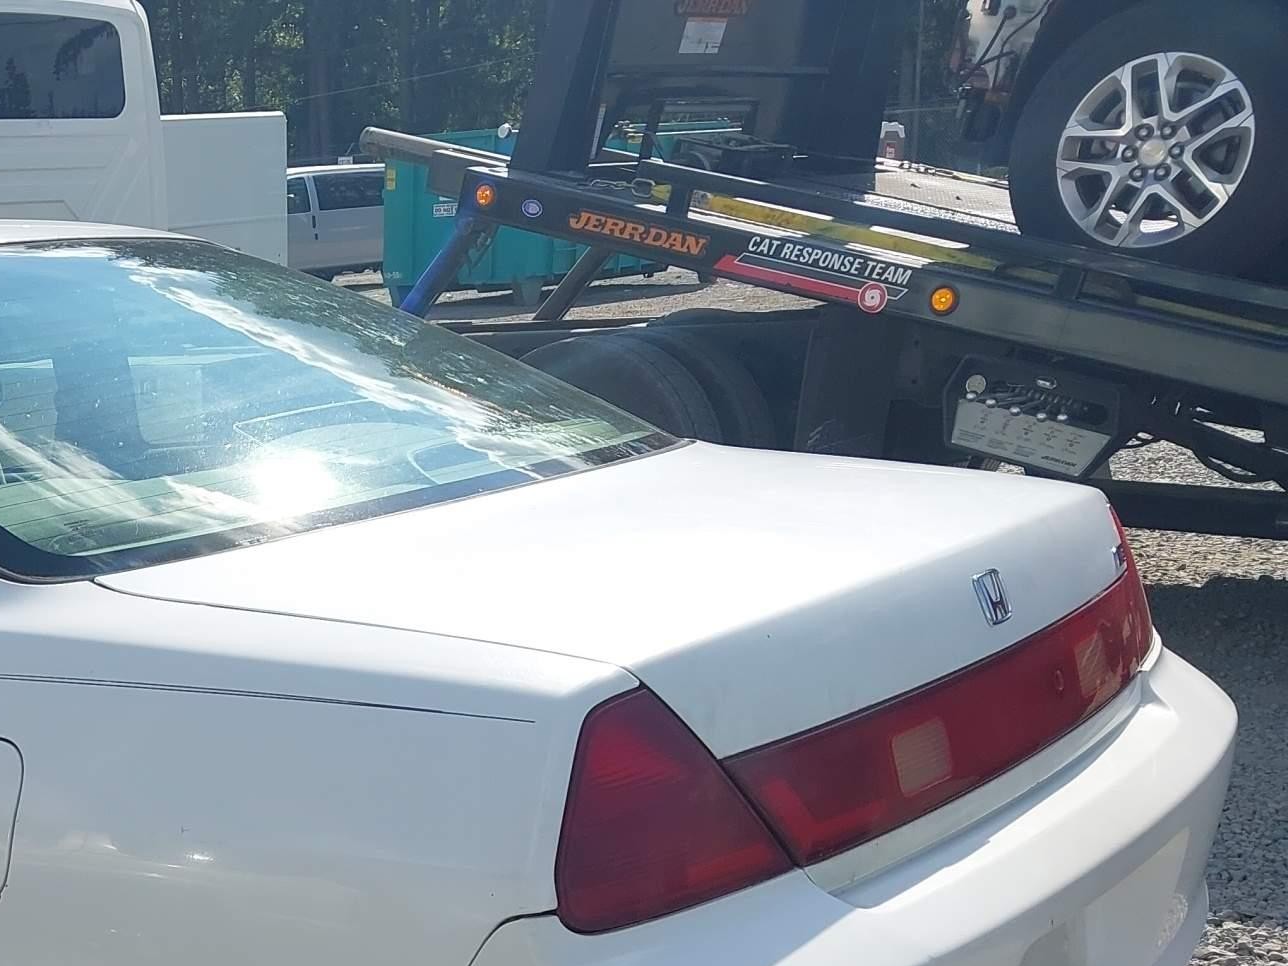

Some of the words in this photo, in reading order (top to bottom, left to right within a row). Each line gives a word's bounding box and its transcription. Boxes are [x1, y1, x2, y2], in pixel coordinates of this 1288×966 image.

[748, 236, 780, 256] CAT
[780, 240, 863, 275] RESPONSE
[862, 260, 911, 285] TEAM
